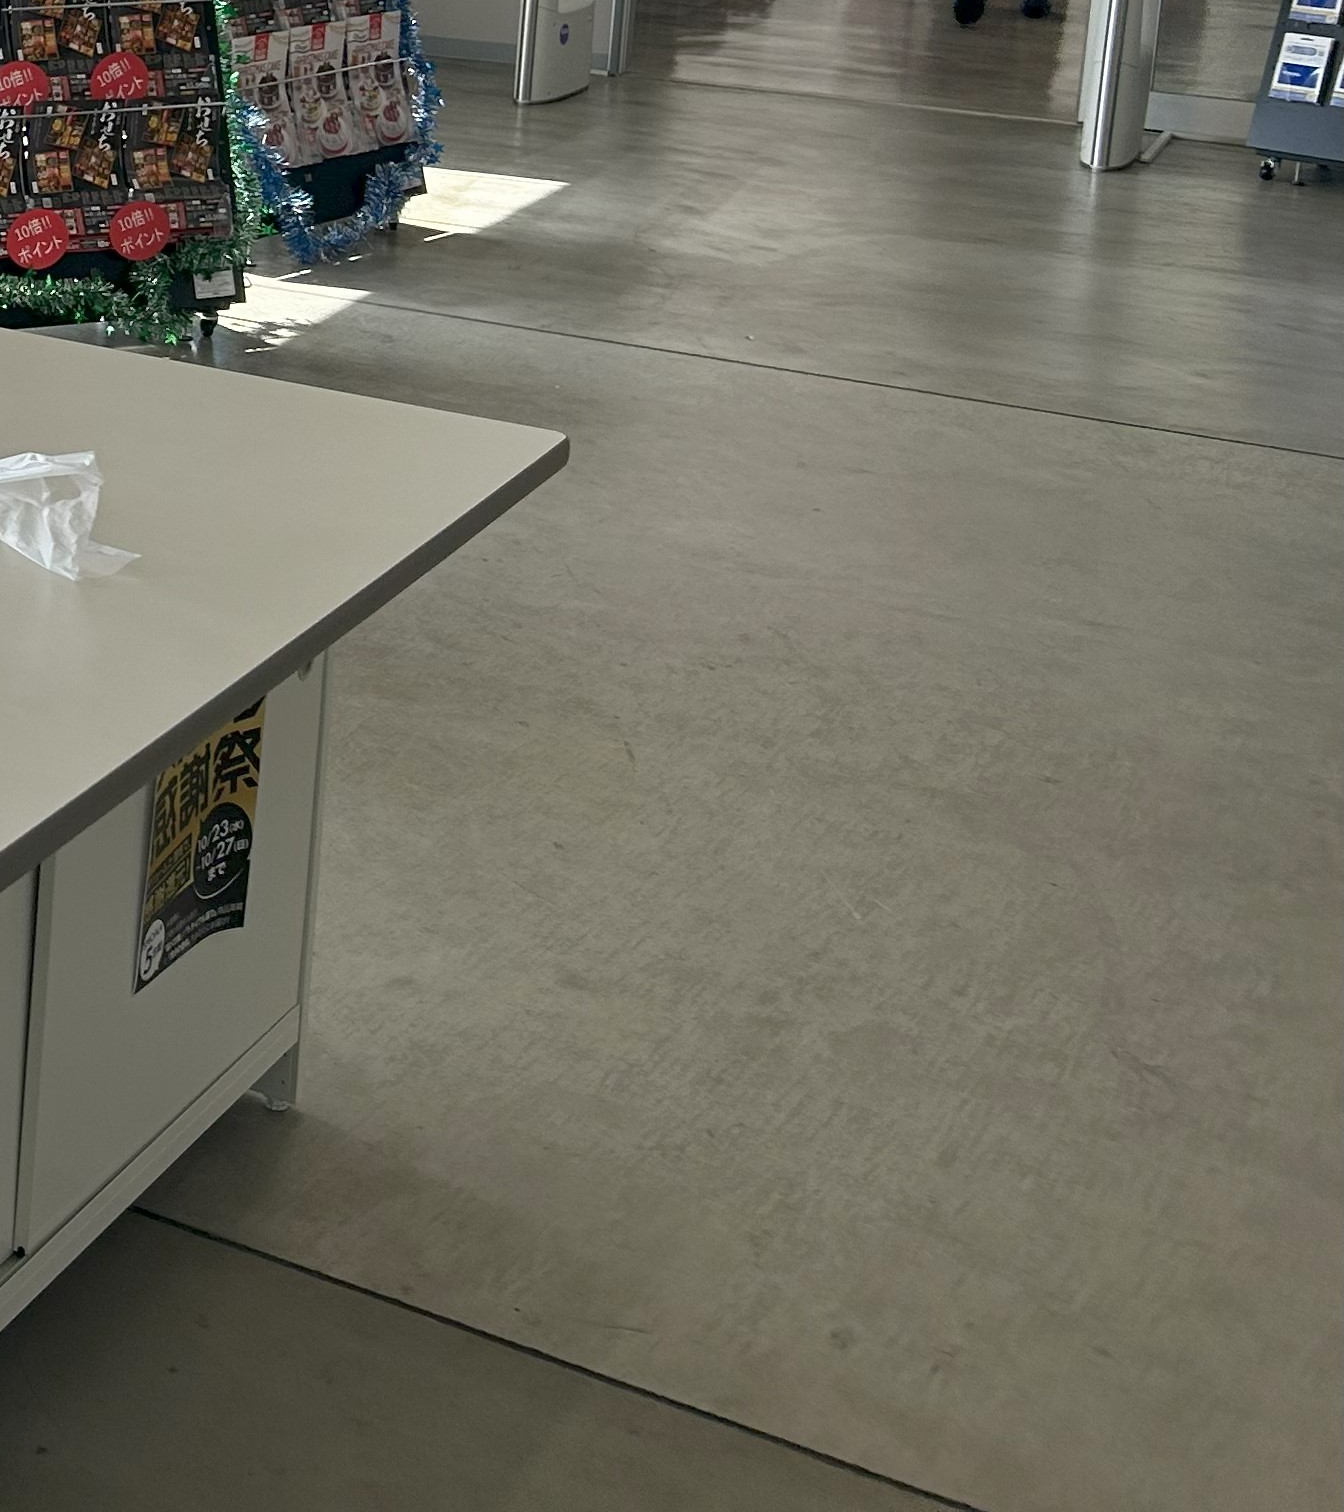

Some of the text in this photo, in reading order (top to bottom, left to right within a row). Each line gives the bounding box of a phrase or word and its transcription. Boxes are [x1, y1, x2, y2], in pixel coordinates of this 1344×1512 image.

[0, 68, 33, 93] 10倍!!
[96, 56, 131, 87] 10倍!!
[14, 215, 52, 242] 10倍!!
[117, 207, 154, 232] 10倍!!
[18, 236, 63, 265] ポイント
[120, 228, 164, 255] ポイント
[207, 862, 226, 883] まで
